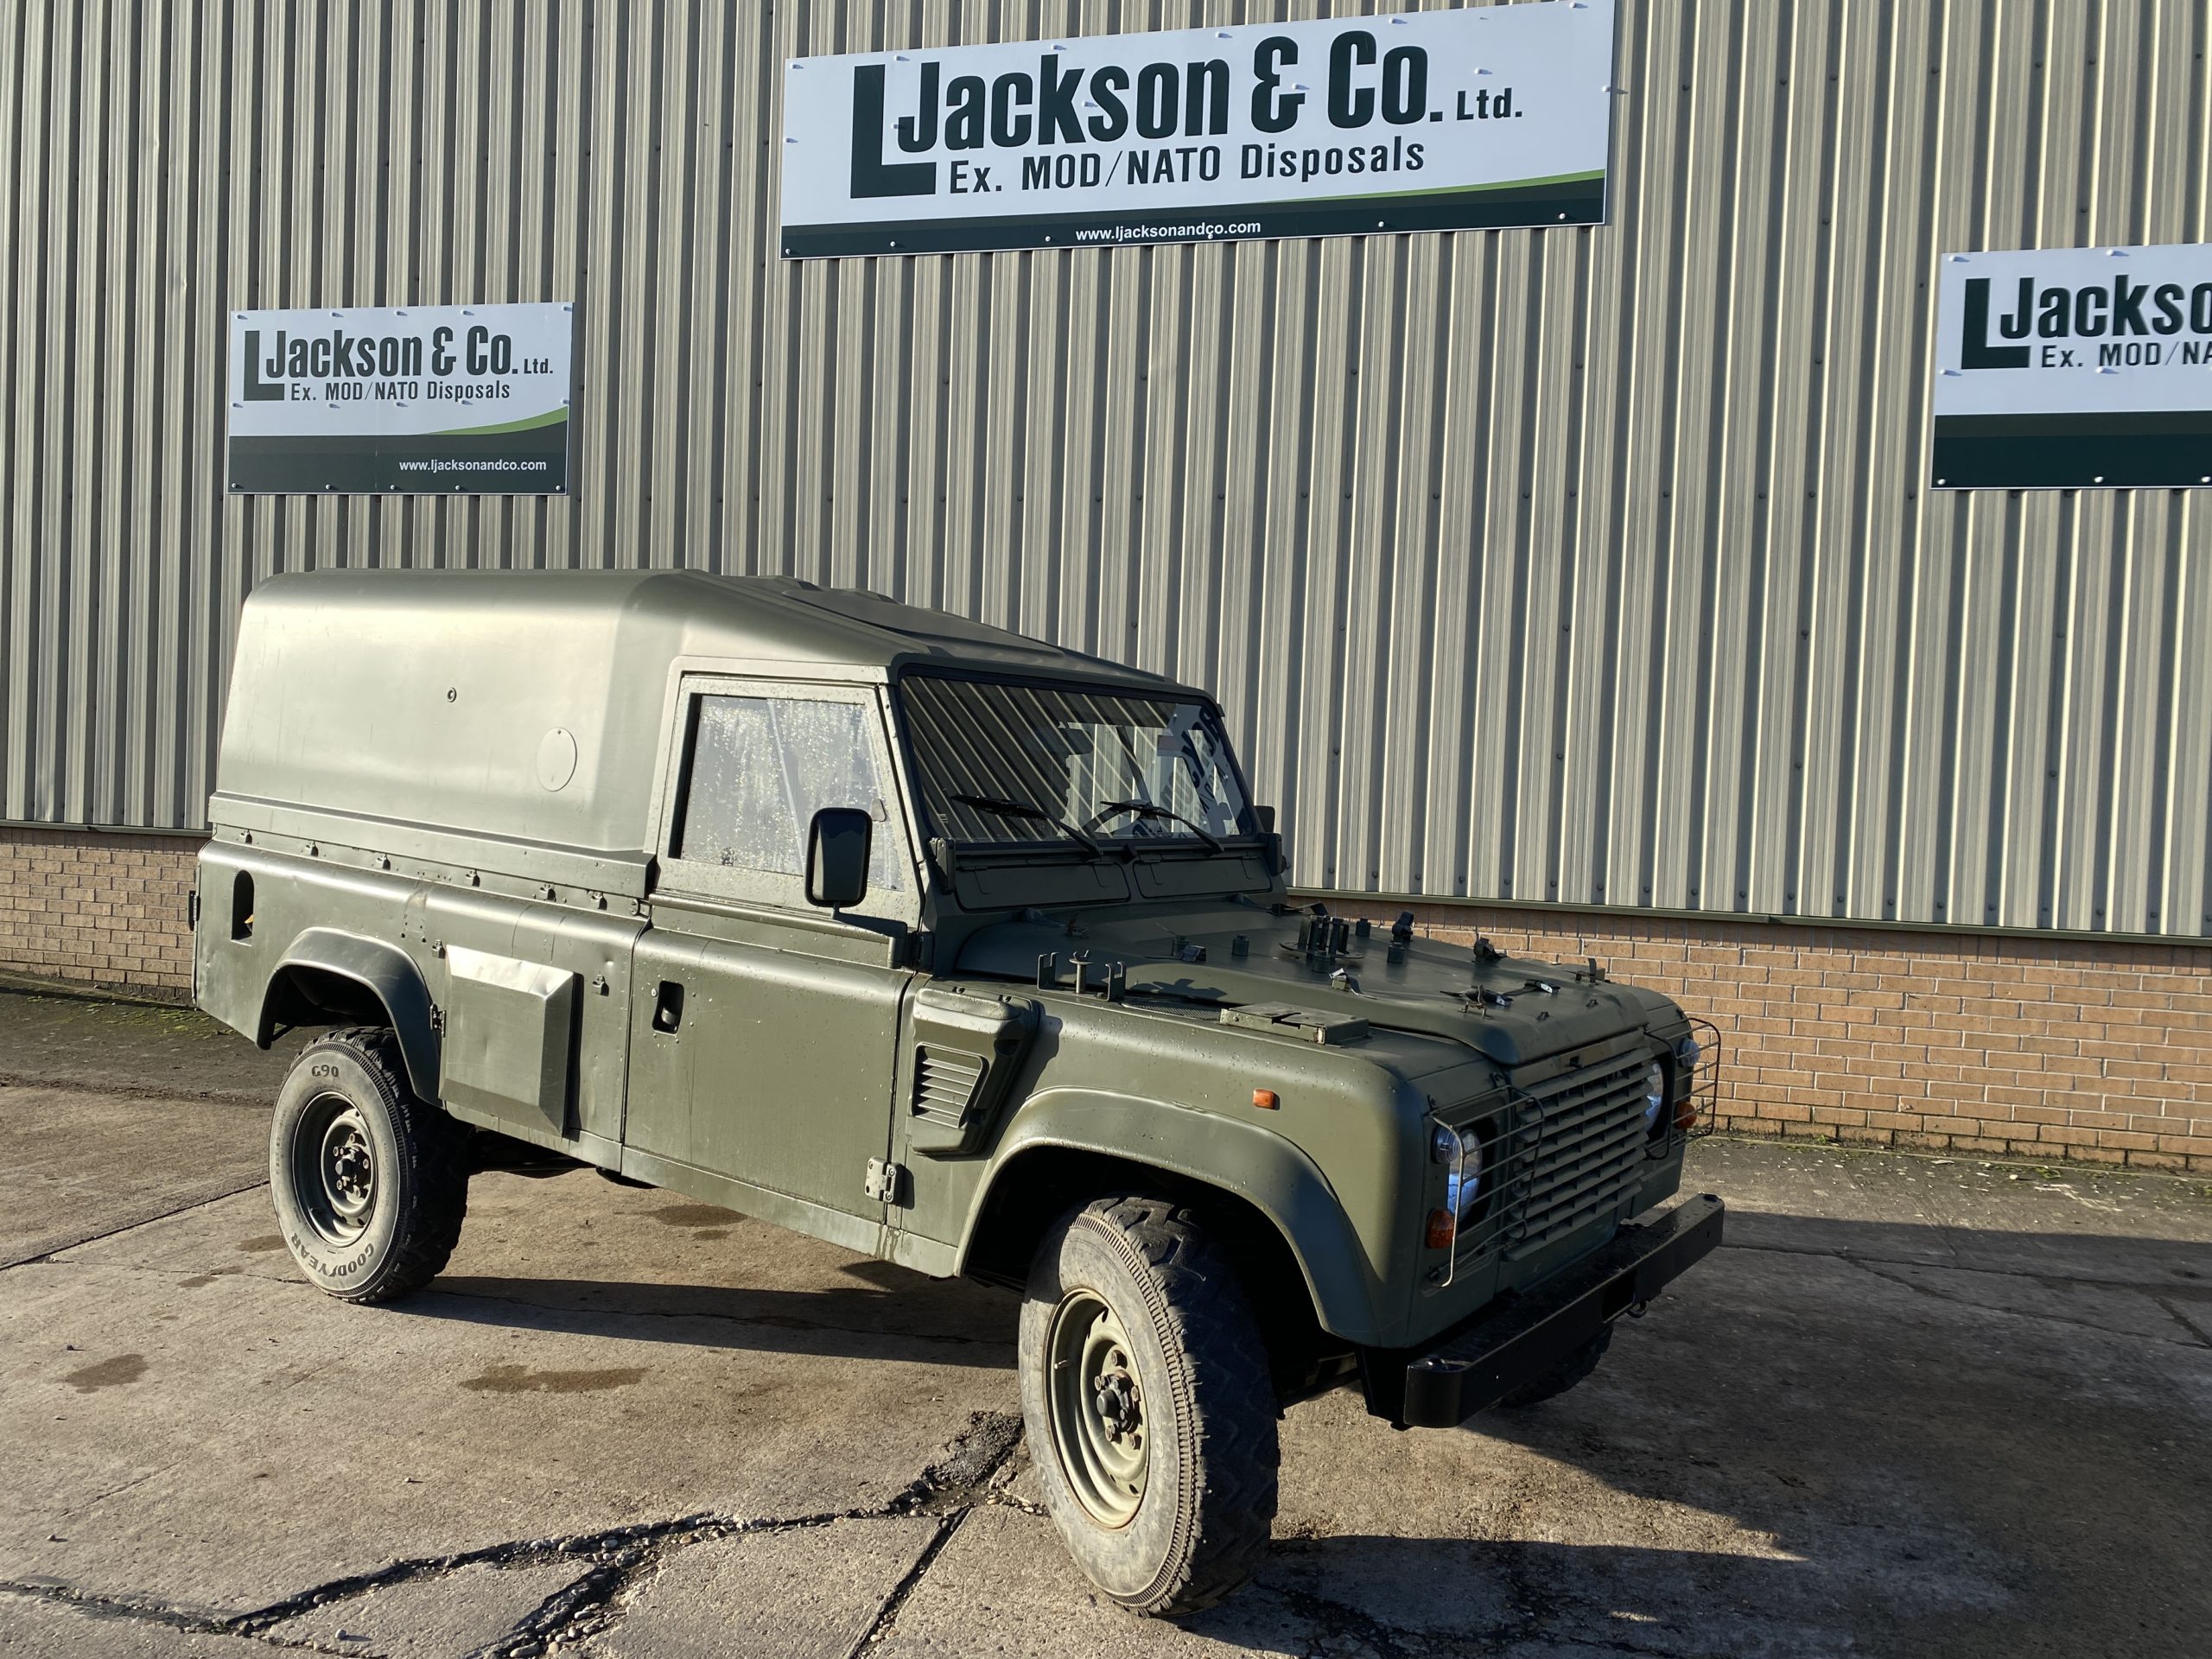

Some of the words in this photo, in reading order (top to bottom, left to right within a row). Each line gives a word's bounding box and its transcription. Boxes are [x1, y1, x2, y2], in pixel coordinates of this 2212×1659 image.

[1250, 35, 1306, 134] &
[1327, 30, 1444, 130] Co.
[1456, 87, 1523, 121] Ltd.
[950, 160, 1002, 194] Ex.
[1021, 143, 1221, 192] MOD/NATO
[1240, 135, 1425, 184] Disposals
[1075, 221, 1262, 242] www.ljacksonandco.com
[431, 326, 457, 377] &
[466, 325, 518, 376] Co.
[523, 358, 554, 374] Ltd.
[2041, 345, 2084, 368] Ex.
[290, 383, 317, 401] Ex.
[325, 380, 418, 401] MOD/NATO
[427, 379, 510, 403] Disposals
[398, 459, 547, 474] www.ljacksonandco.com
[291, 1232, 375, 1278] GOODYEAR
